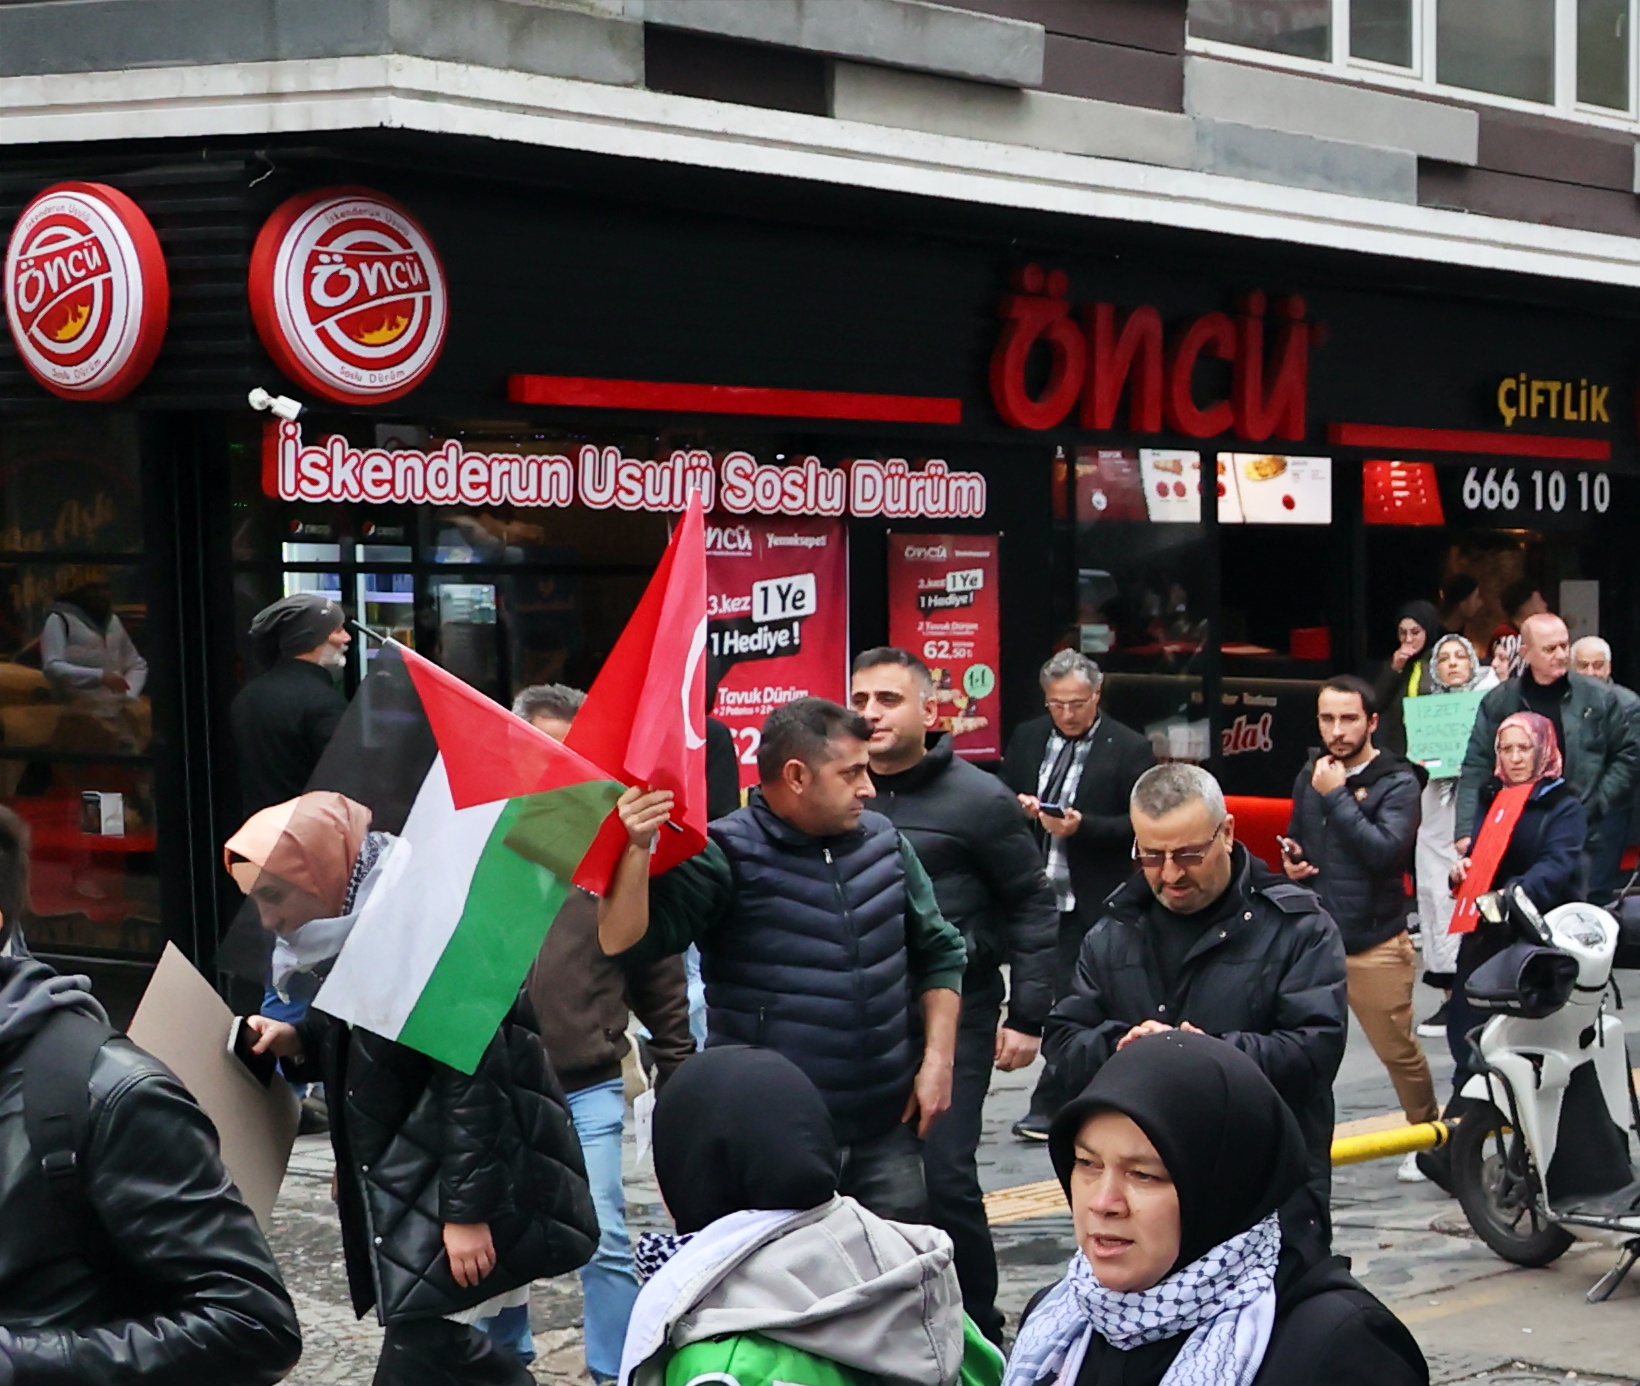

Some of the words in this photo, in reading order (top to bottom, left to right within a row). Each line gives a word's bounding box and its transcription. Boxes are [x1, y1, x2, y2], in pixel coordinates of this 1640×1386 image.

[16, 241, 102, 313] Öncü
[310, 253, 423, 308] Öncü
[1496, 372, 1611, 428] ÇİFTLİK
[278, 420, 574, 508] İskenderun
[578, 444, 714, 513] Usulü
[721, 451, 846, 516] Soslu
[850, 458, 987, 518] Dürüm
[1462, 466, 1520, 511] 666
[1531, 469, 1566, 513] 10
[1577, 470, 1611, 514] 10
[705, 525, 753, 551] ncü
[759, 585, 770, 615] 1
[776, 581, 807, 613] Ye
[960, 574, 979, 588] Ye
[710, 632, 720, 657] 1
[717, 686, 763, 705] Tavuk
